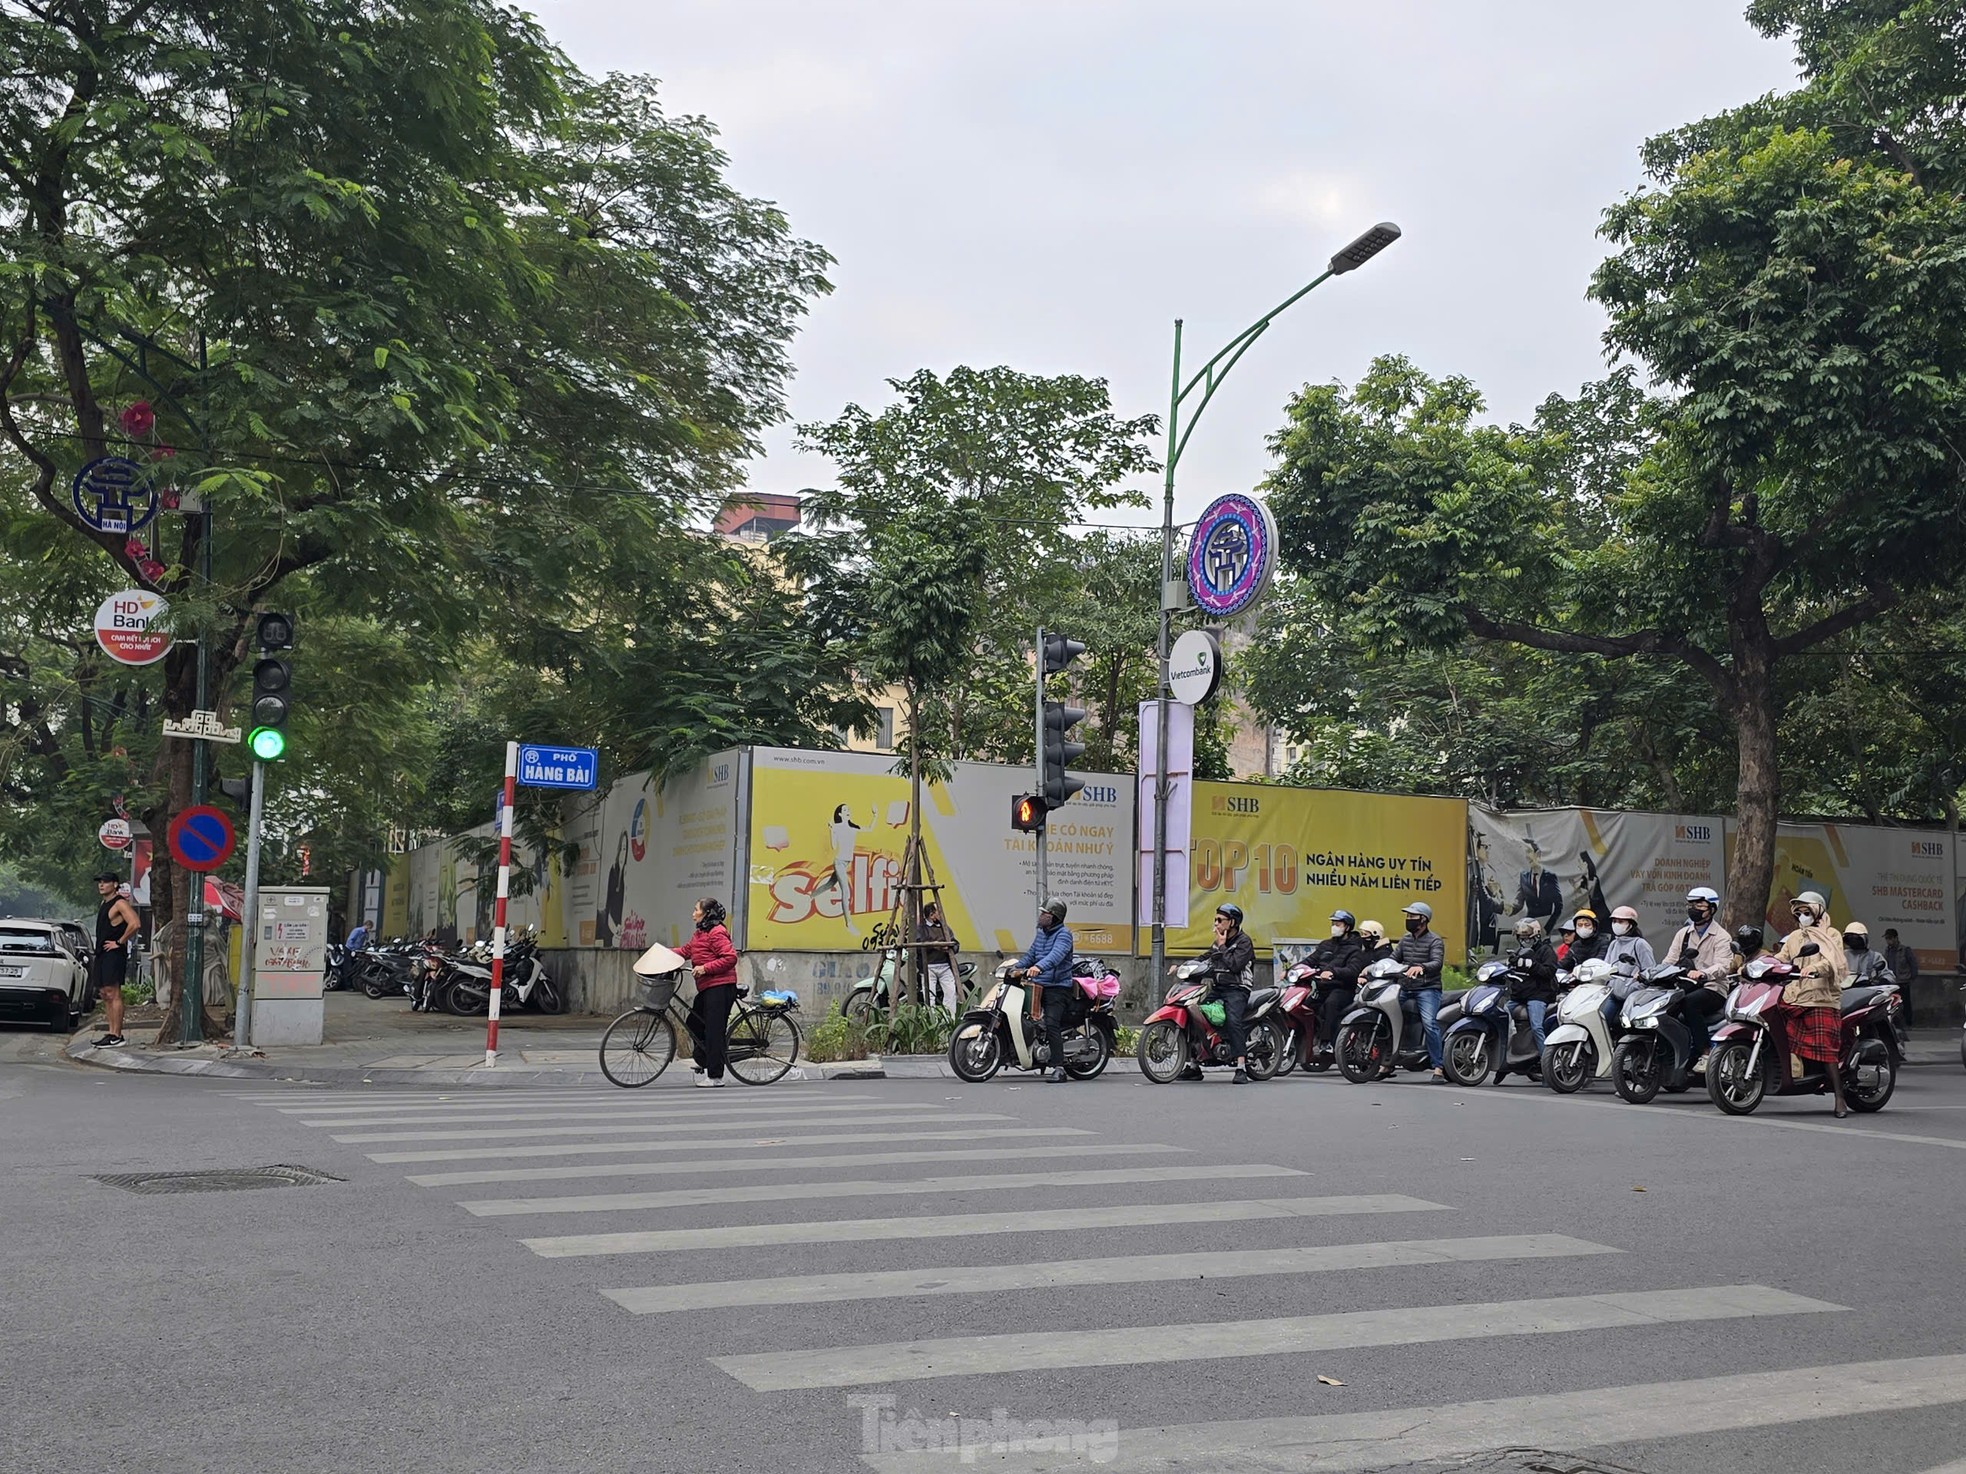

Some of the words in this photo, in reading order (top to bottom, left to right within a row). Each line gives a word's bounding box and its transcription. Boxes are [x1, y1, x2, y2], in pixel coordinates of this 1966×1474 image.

[114, 601, 138, 614] HD
[1170, 665, 1211, 680] Vietcombank
[553, 751, 577, 762] PHỐ
[773, 756, 825, 765] www.shb.com.vn
[525, 762, 564, 781] HÀNG
[566, 765, 589, 783] BÀI
[714, 764, 729, 783] SHB
[1083, 786, 1117, 802] SHB
[1227, 796, 1259, 813] SHB
[1060, 822, 1077, 836] CÓ
[1080, 825, 1114, 838] NGAY
[1686, 825, 1711, 840] SHB
[1028, 838, 1073, 853] KOẢN
[1076, 841, 1104, 854] NHƯ
[1921, 842, 1943, 856] SHB
[1254, 842, 1299, 896] 10
[1306, 851, 1344, 867] NGÂN
[1348, 852, 1386, 869] HÀNG
[1388, 858, 1406, 870] UY
[1410, 856, 1432, 872] TÍN
[1306, 868, 1347, 886] NHIỀU
[1350, 872, 1379, 888] NĂM
[1382, 874, 1410, 890] LIÊN
[1413, 873, 1442, 891] TIẾP
[1664, 871, 1682, 880] KINH
[1684, 871, 1711, 881] DOANH
[769, 853, 906, 924] selfi
[1872, 885, 1888, 896] SHB
[1889, 886, 1944, 899] MASTERCARD
[1901, 899, 1944, 912] CASHBACK
